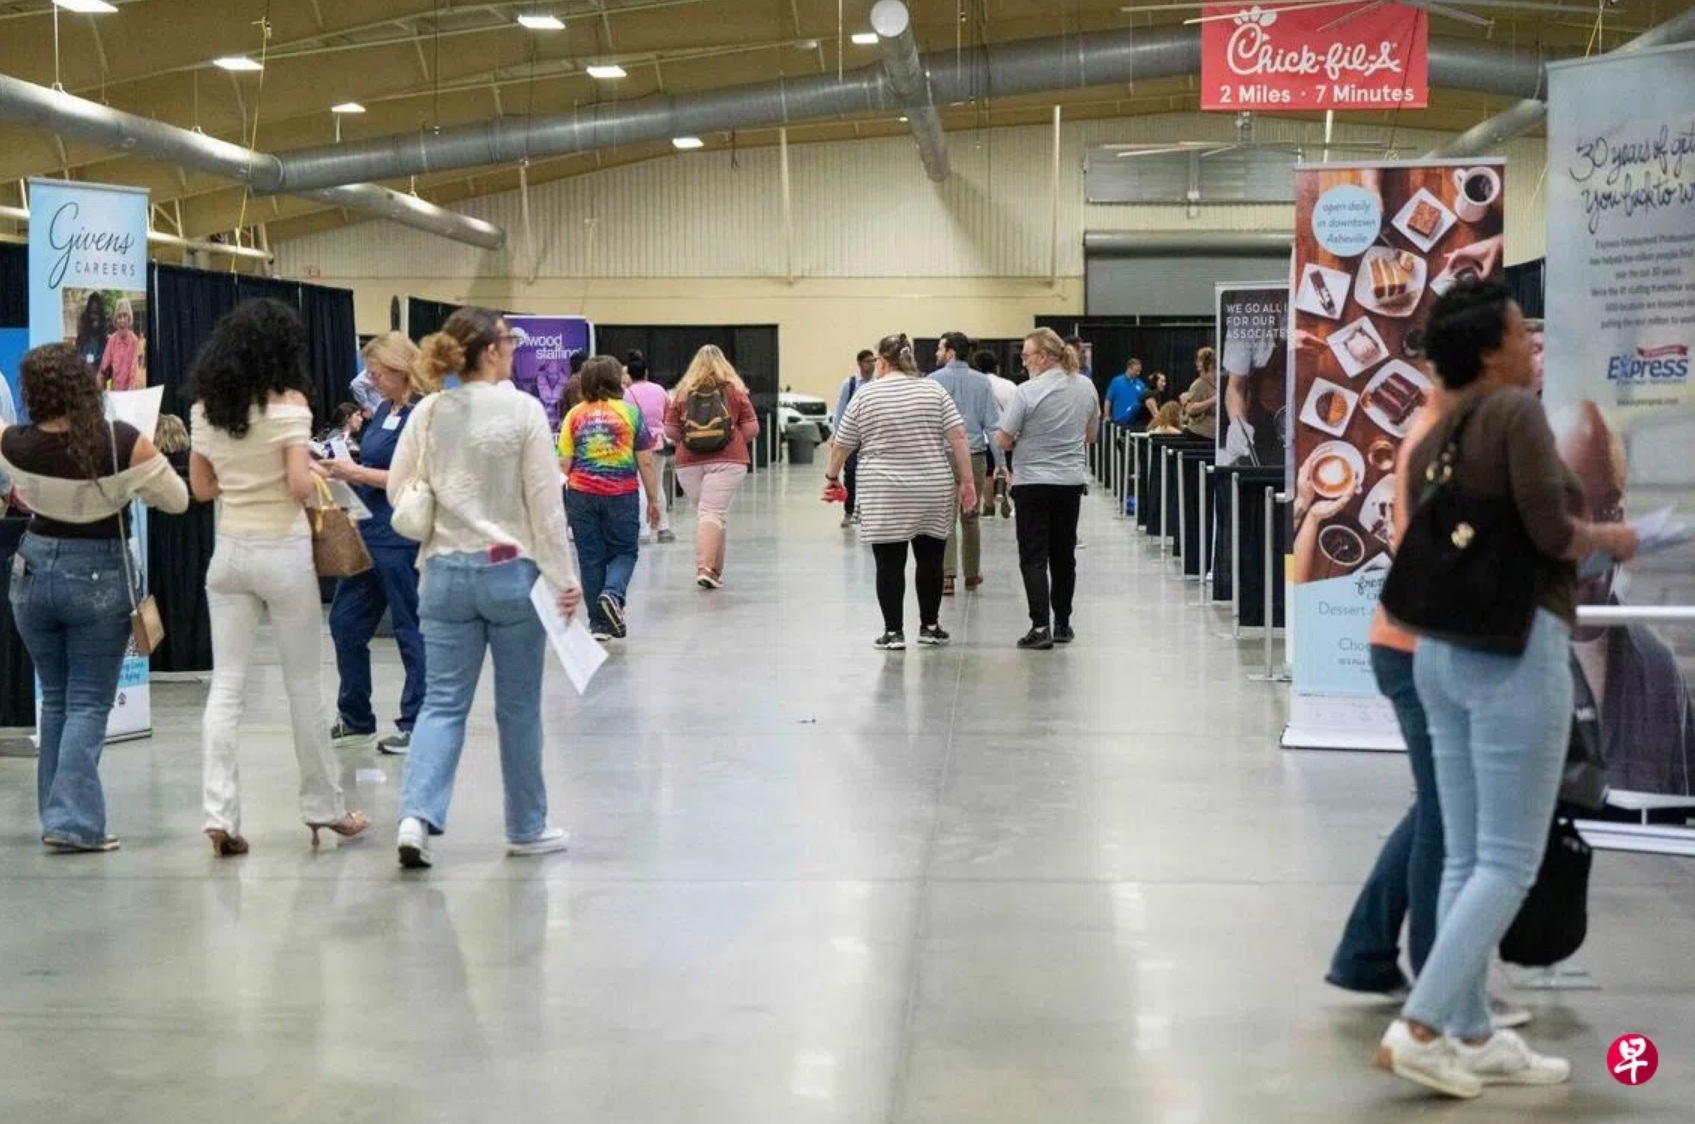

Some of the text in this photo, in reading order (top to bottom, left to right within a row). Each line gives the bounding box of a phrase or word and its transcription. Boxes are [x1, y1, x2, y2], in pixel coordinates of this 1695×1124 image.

[1227, 22, 1401, 80] Chick-fil-A
[1220, 86, 1414, 103] 2 Miles 7 Minutes
[1569, 137, 1608, 182] 30
[1328, 218, 1376, 228] downtown
[49, 202, 135, 289] Givens
[75, 261, 135, 277] CAREERS
[1226, 303, 1242, 313] WE
[1245, 303, 1260, 313] GO
[1262, 303, 1282, 313] ALL
[1226, 315, 1275, 326] FOR OUR
[1607, 355, 1688, 380] Express
[1319, 601, 1365, 616] Dessert
